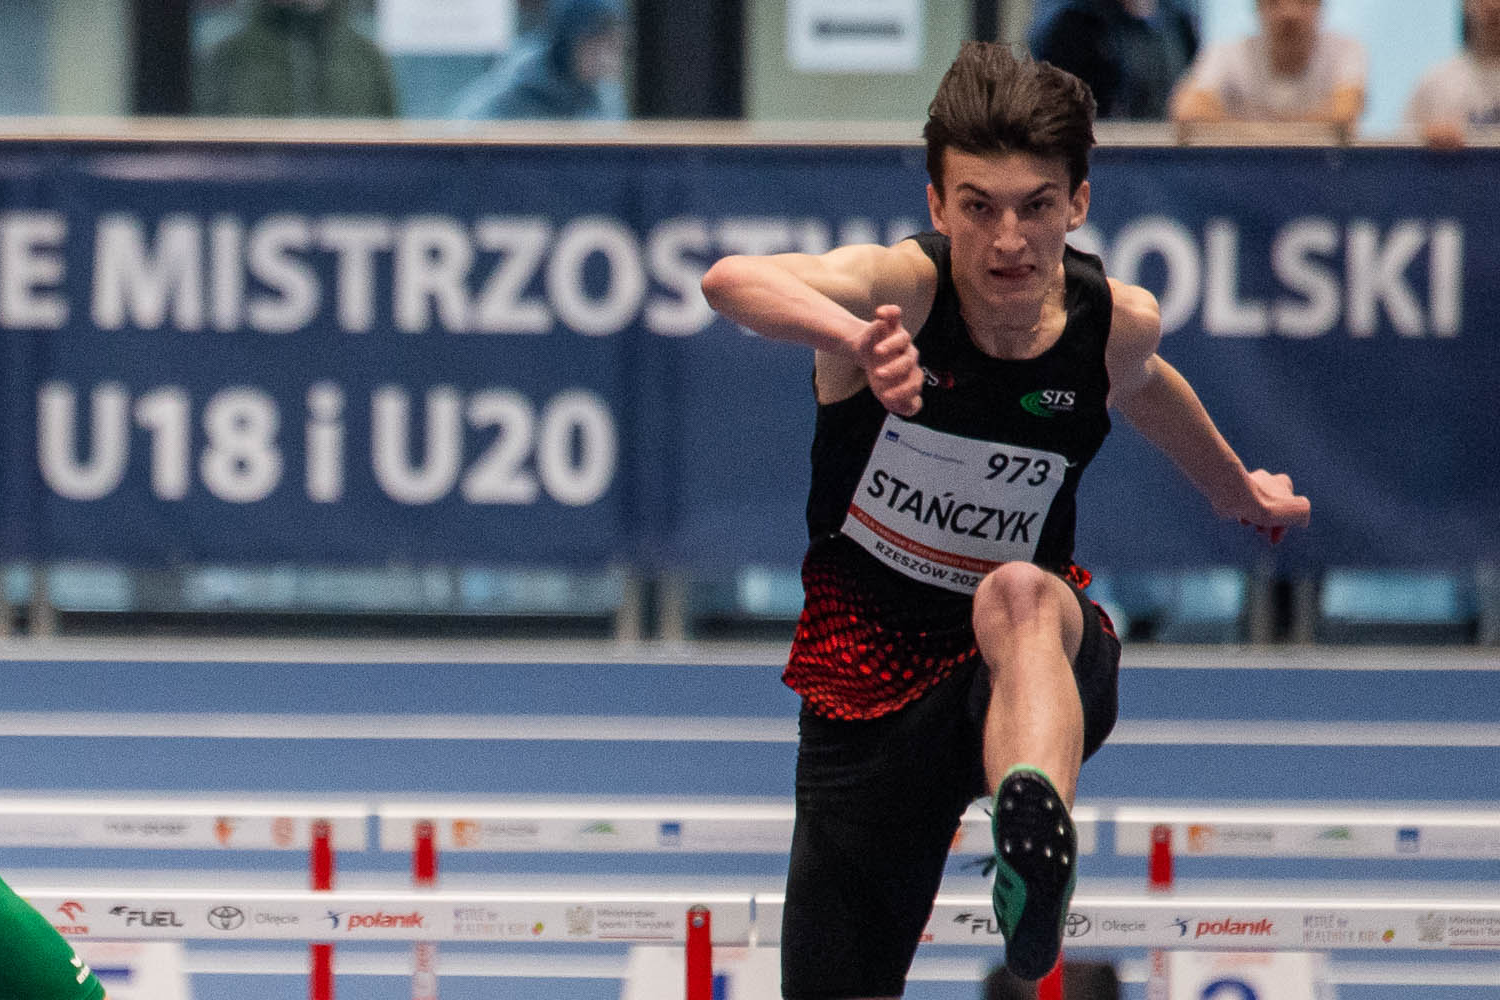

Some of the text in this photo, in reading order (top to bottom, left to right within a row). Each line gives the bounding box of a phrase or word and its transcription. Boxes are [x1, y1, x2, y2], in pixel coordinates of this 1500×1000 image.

[1066, 214, 1464, 339] OLSKI
[1040, 389, 1077, 406] STS
[36, 378, 618, 506] U18 i U20
[984, 452, 1052, 488] 973
[866, 468, 1040, 544] STAŃCZYK
[875, 540, 982, 588] RZESZÓW 202
[126, 910, 185, 927] FUEL
[348, 910, 425, 931] polanik
[971, 917, 1001, 935] FU
[1195, 916, 1275, 938] polanik
